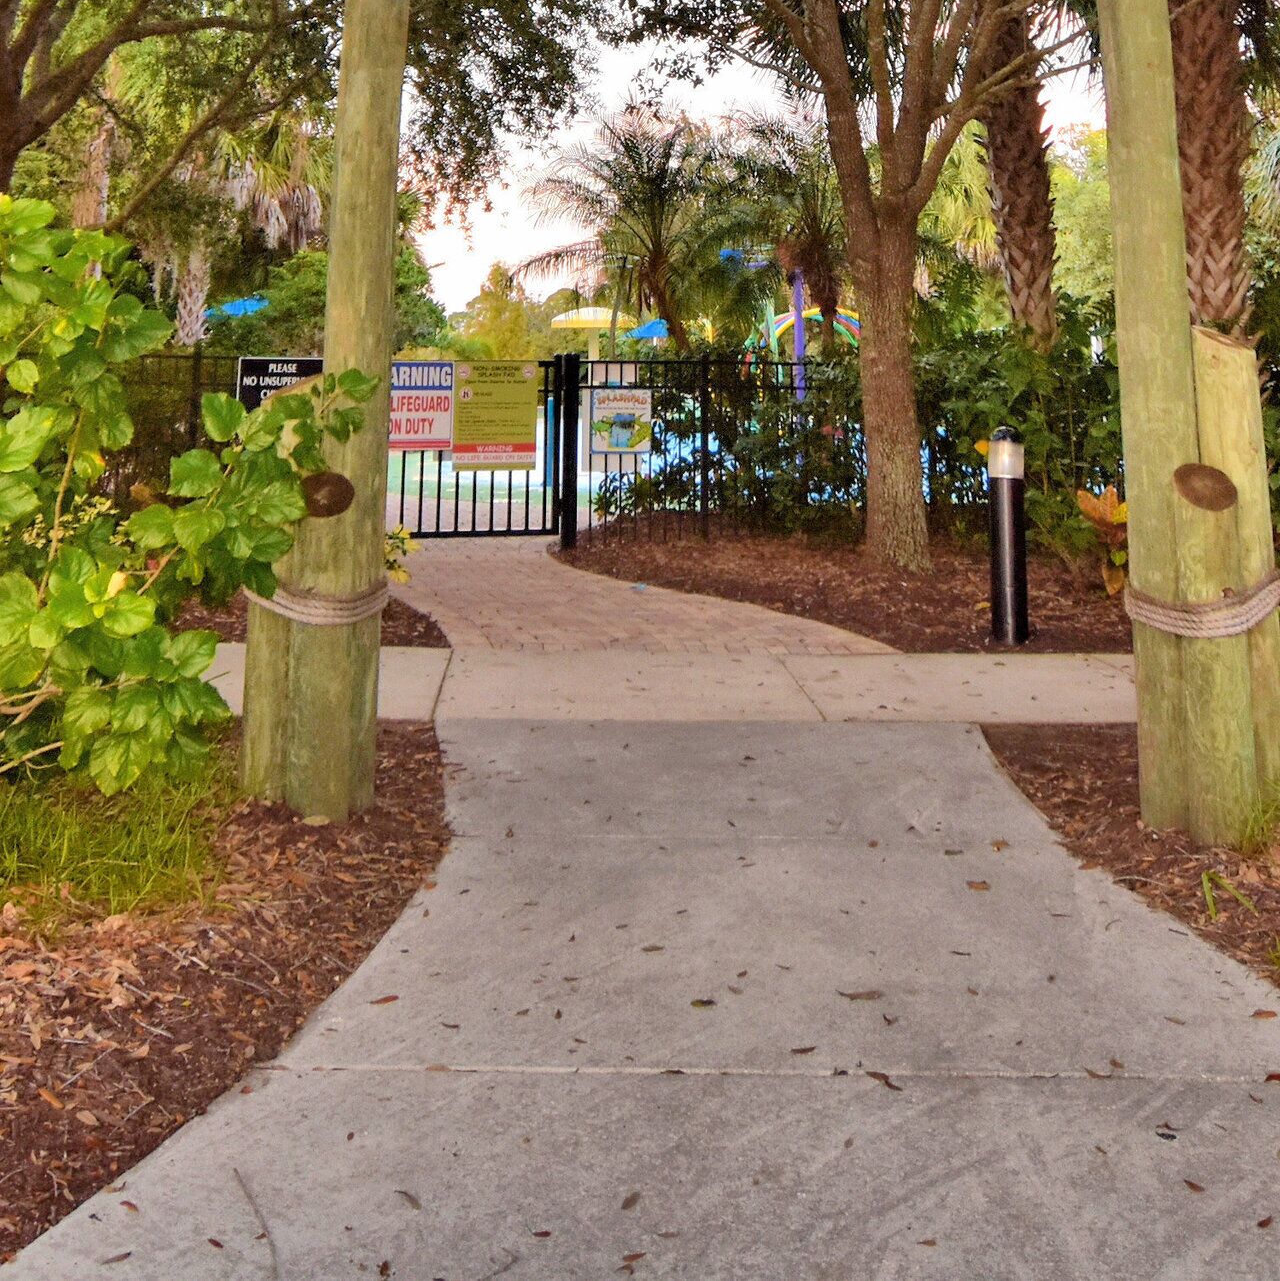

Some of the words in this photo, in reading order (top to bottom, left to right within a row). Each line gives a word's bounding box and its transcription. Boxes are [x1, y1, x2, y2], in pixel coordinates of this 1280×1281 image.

[268, 363, 298, 374] PLEASE
[242, 375, 258, 387] NO
[391, 365, 452, 387] ARNING
[390, 395, 450, 413] LIFEGUARD
[405, 418, 434, 435] DUTY
[476, 444, 513, 453] WARNING
